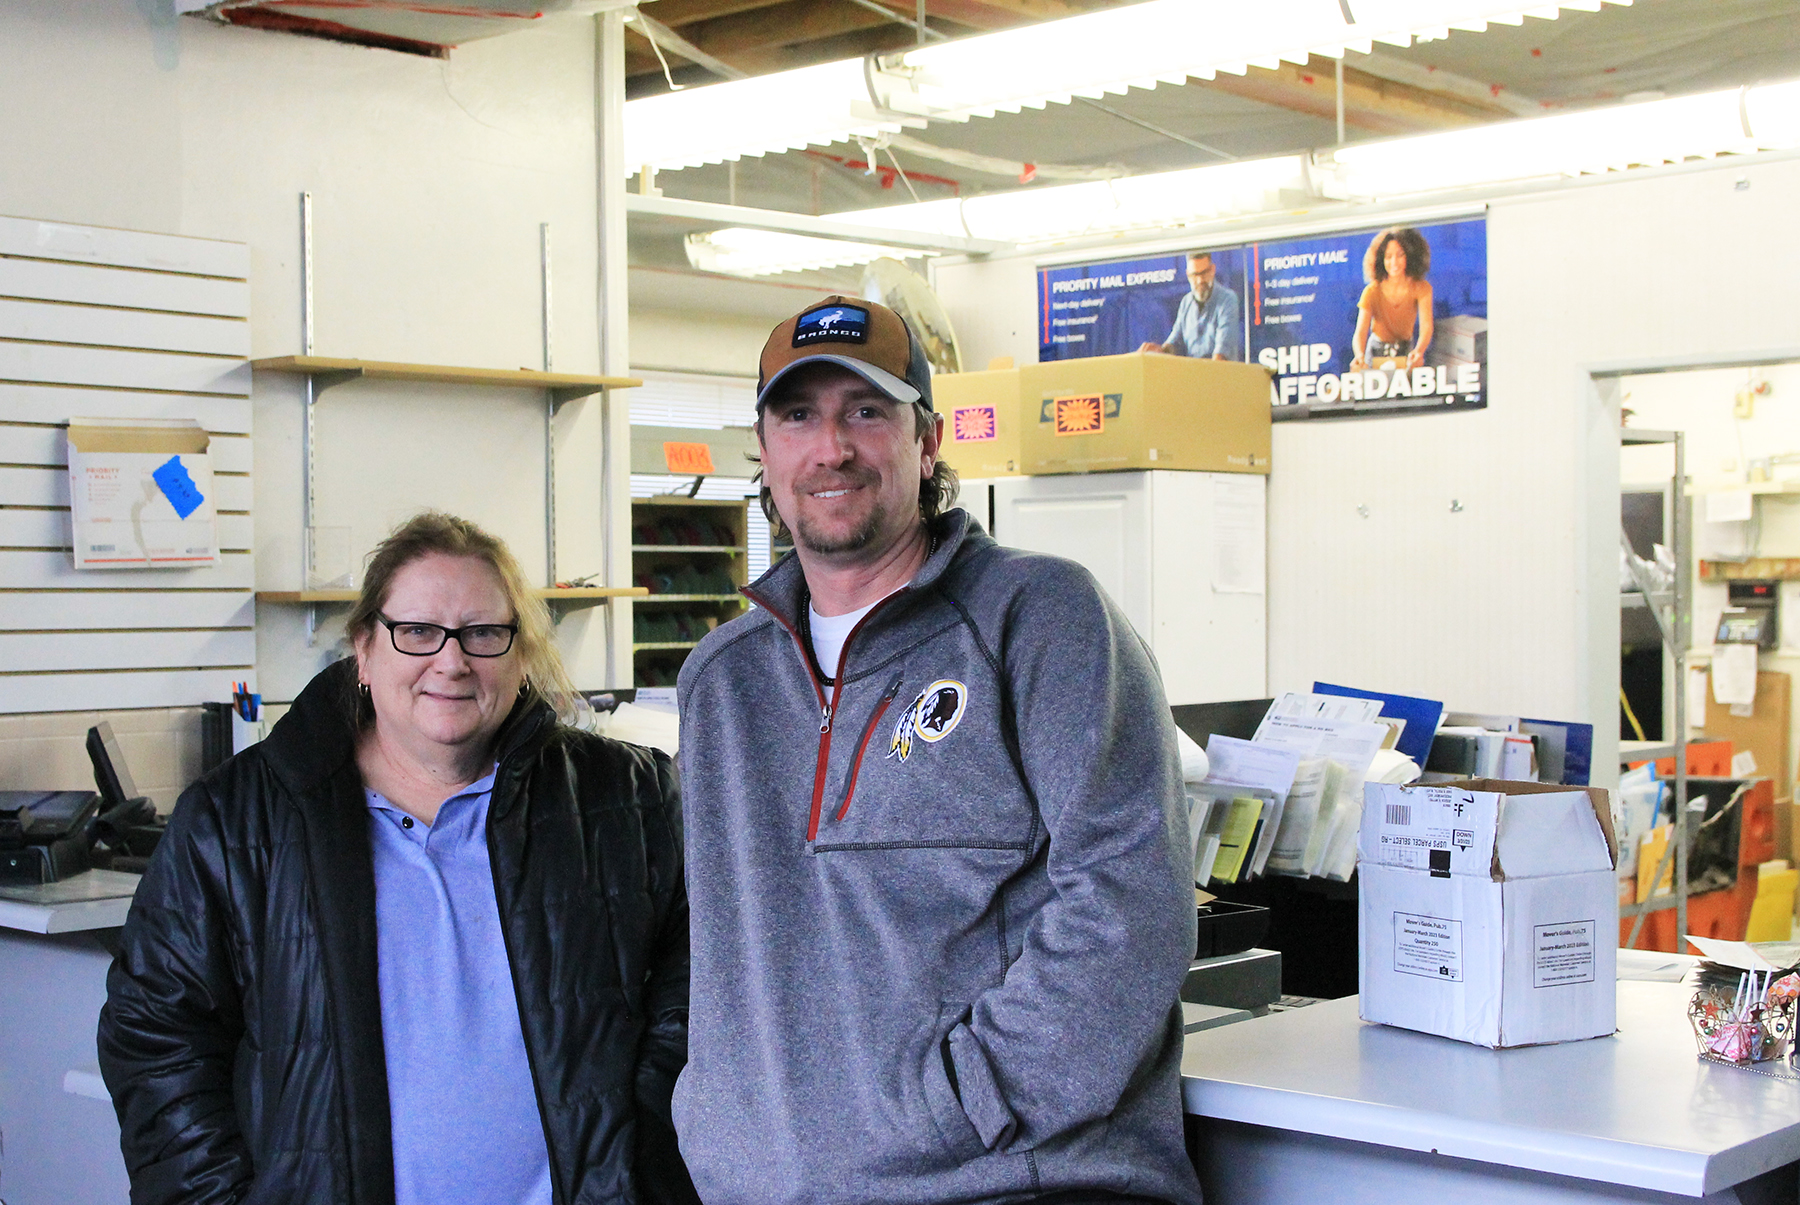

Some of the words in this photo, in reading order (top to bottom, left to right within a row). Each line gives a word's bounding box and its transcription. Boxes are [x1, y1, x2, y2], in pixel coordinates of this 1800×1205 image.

[1264, 253, 1318, 271] PRIORITY
[1052, 278, 1099, 293] PRIORITY
[1100, 275, 1126, 289] MAIL
[1258, 342, 1332, 375] SHIP
[1393, 836, 1411, 846] SELECT
[1412, 839, 1432, 848] PARCEL
[1433, 841, 1448, 849] USPS
[1414, 937, 1431, 946] Quantity
